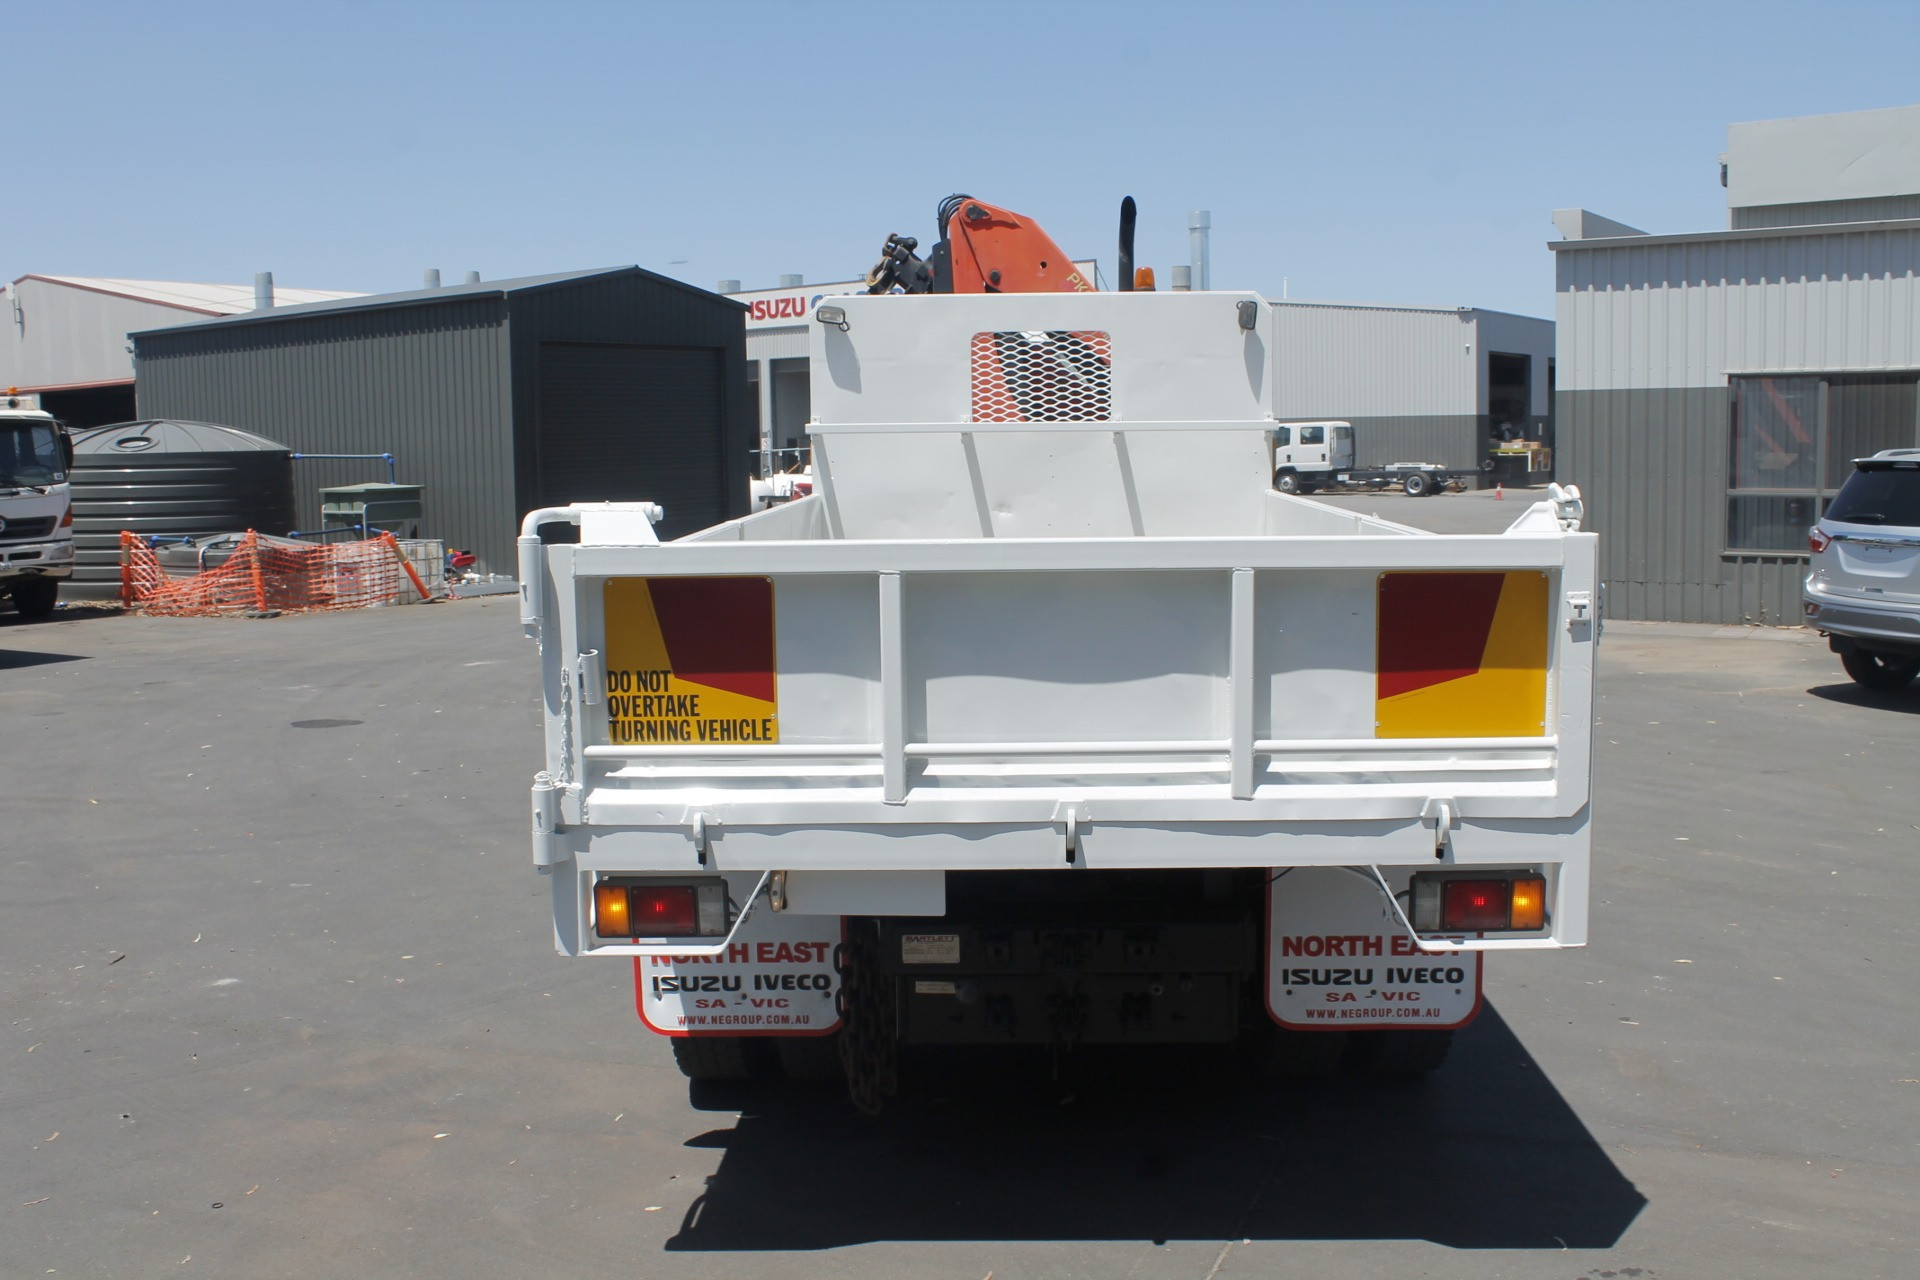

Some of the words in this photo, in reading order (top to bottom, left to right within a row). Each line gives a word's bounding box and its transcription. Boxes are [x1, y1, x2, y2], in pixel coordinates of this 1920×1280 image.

[749, 296, 806, 320] ISUZU
[607, 670, 632, 693] DO
[636, 669, 672, 693] NOT
[608, 694, 700, 718] OVERTAKE
[609, 719, 691, 743] TURNING
[696, 718, 773, 742] VEHICLE
[757, 942, 830, 964] EAST
[1282, 935, 1383, 957] NORTH
[652, 974, 741, 992] ISUZU
[754, 973, 832, 991] IVECO
[1282, 968, 1373, 986] ISUZU
[1386, 967, 1465, 984] IVECO
[695, 998, 726, 1009] SA
[751, 998, 790, 1008] VIC
[1325, 992, 1357, 1002] SA
[1381, 991, 1421, 1002] VIC
[677, 1014, 810, 1026] WWW.NEGROUP.COM.AU
[1306, 1008, 1441, 1019] WWW.NEGROUP.COM.AU
